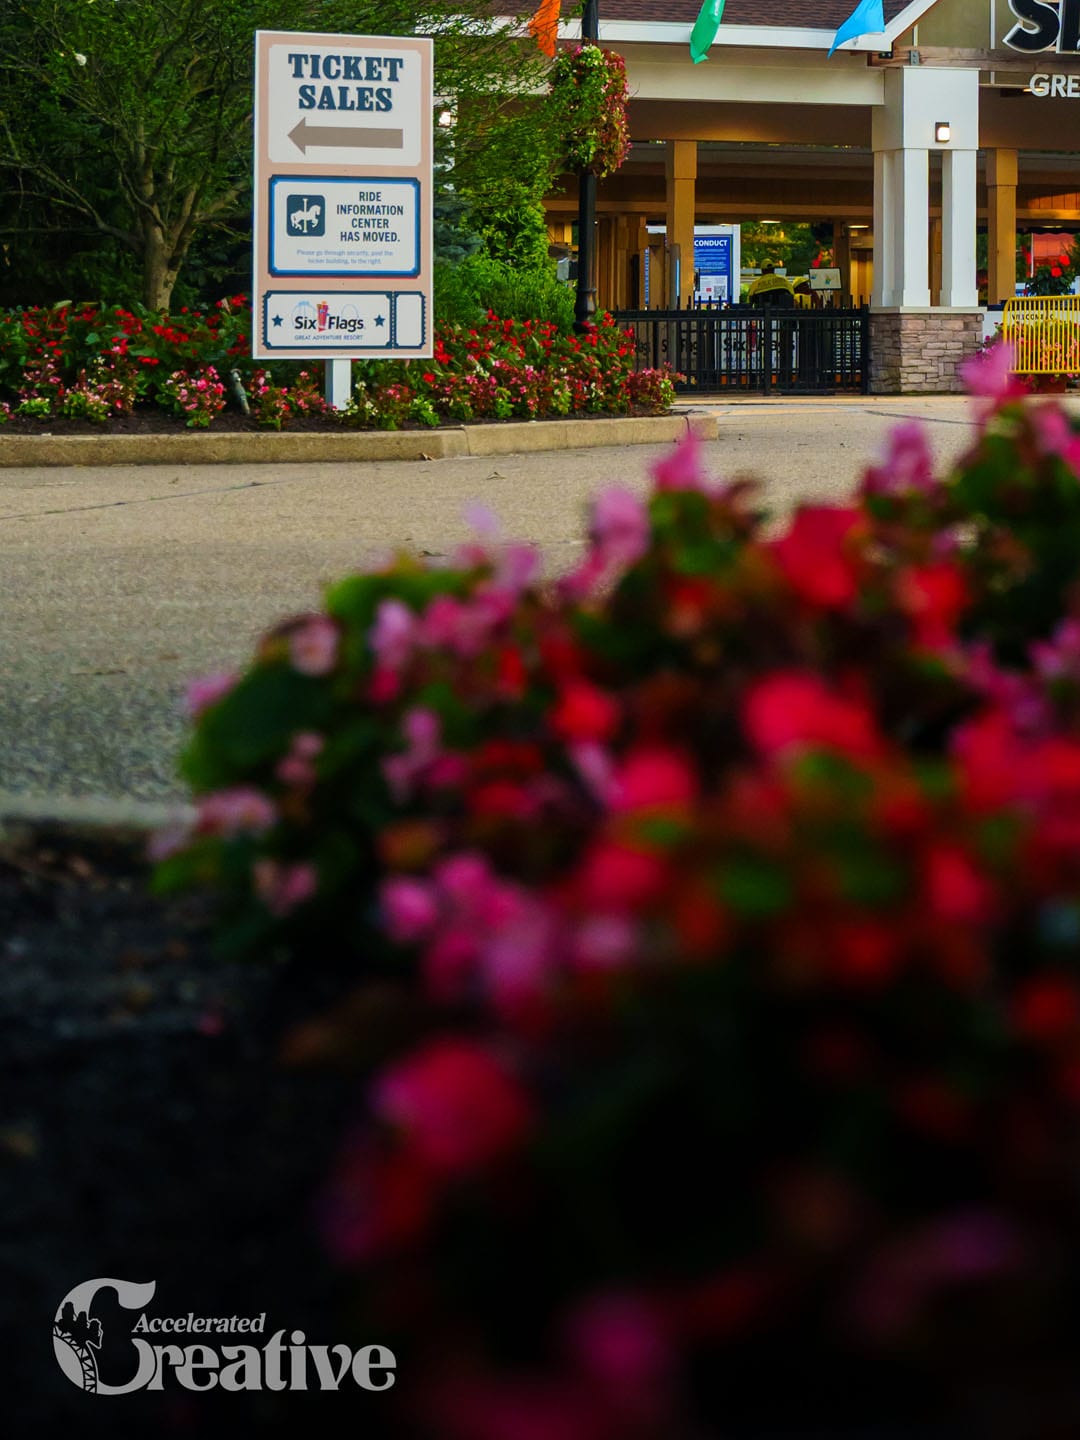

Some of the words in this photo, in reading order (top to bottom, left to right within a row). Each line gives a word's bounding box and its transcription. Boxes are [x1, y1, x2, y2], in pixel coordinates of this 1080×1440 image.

[288, 53, 404, 82] TICKET
[298, 84, 393, 112] SALES
[359, 191, 382, 201] RIDE
[336, 204, 404, 215] INFORMATION
[351, 218, 389, 228] CENTER
[340, 231, 360, 242] HAS
[363, 231, 400, 242] MOVED.
[694, 239, 727, 247] CONDUCT
[294, 316, 317, 329] Six
[328, 316, 364, 332] Flags
